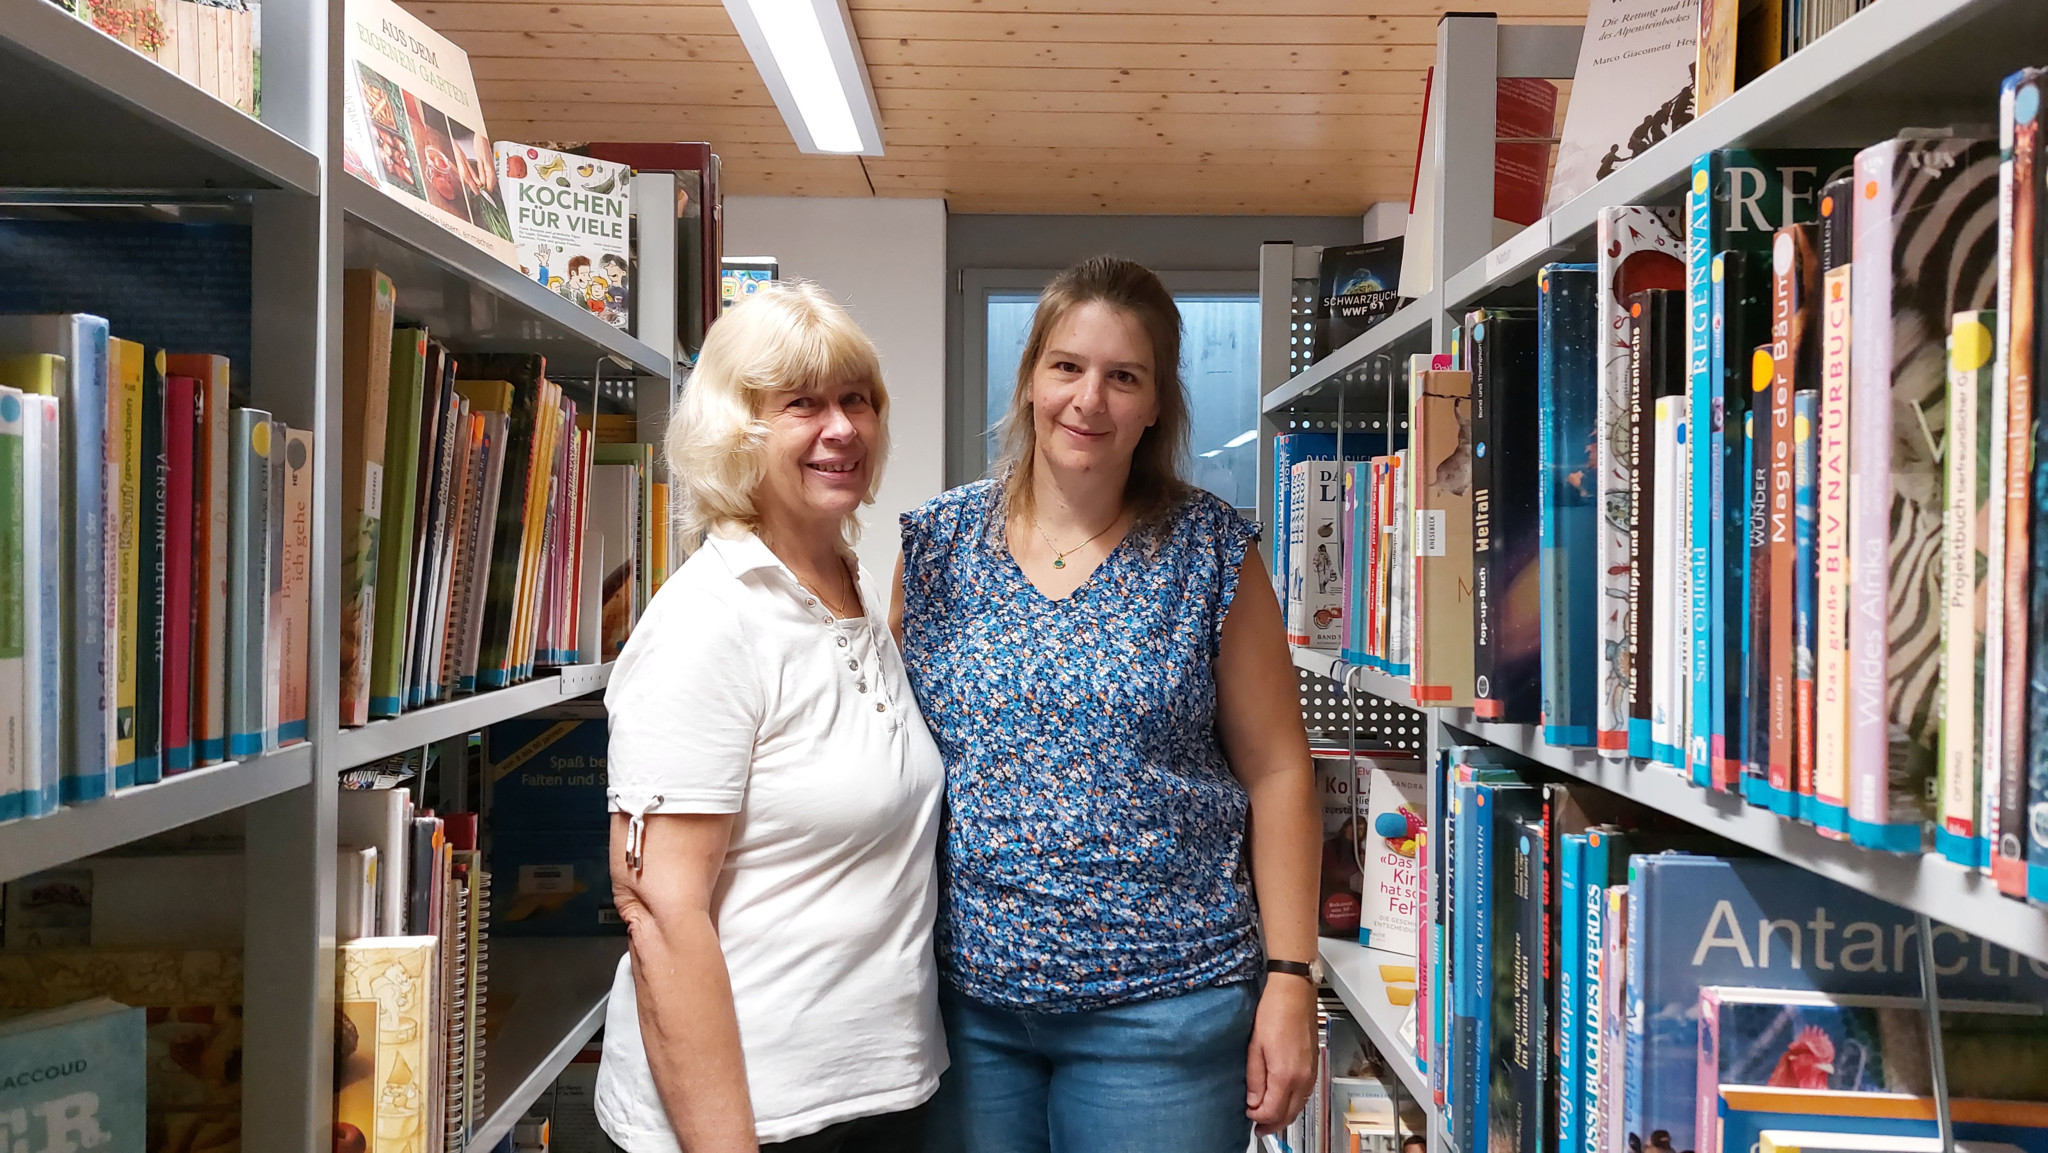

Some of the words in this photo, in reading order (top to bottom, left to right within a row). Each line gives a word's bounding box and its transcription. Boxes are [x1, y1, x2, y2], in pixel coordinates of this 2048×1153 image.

[1599, 28, 1613, 41] des
[1614, 13, 1691, 38] Alpensteinbockes
[1602, 16, 1619, 28] Die
[1621, 10, 1659, 24] Rettung
[1661, 2, 1679, 14] und
[356, 22, 417, 75] EIGENEN
[419, 64, 470, 108] GARTEN
[382, 18, 408, 48] AUS
[408, 36, 440, 69] DEM
[1593, 54, 1620, 67] Marco
[1623, 43, 1671, 59] Giacometti
[519, 183, 623, 218] KOCHEN
[519, 205, 560, 228] FÜR
[567, 214, 623, 240] VIELE
[1724, 164, 1854, 233] RE
[1693, 155, 1708, 375] REGENWAL
[1323, 289, 1398, 307] SCHWARZBUCH
[1342, 306, 1368, 317] WWF
[1773, 275, 1788, 361] Bäum
[1631, 326, 1641, 422] Spitzenkochs
[1773, 375, 1788, 428] der
[124, 397, 133, 482] gewachsen
[1631, 427, 1641, 465] eines
[1956, 388, 1968, 497] tierfreundlicher
[442, 468, 450, 506] KOCHEN
[1630, 469, 1641, 526] Rezepte
[1755, 468, 1767, 547] WUNDER
[1772, 440, 1790, 543] Magie
[85, 512, 97, 535] der
[119, 482, 134, 550] Kraut
[293, 501, 308, 548] gehe
[1475, 488, 1489, 553] Weltall
[85, 539, 97, 572] Buch
[121, 551, 130, 575] ein
[1630, 531, 1640, 556] und
[1826, 514, 1841, 574] BLV
[1952, 498, 1969, 608] Projektbuch
[85, 574, 97, 616] große
[107, 513, 117, 629] Babymassage
[121, 577, 129, 595] ist
[156, 558, 165, 606] DEIN
[282, 540, 293, 599] Bevor
[293, 558, 304, 582] ich
[1694, 547, 1708, 633] Oldfield
[1859, 537, 1883, 621] Afrika
[119, 597, 128, 632] alles
[1479, 567, 1487, 646] Pop-up-Buch
[1630, 562, 1640, 654] Sammeltipps
[1829, 584, 1839, 650] große
[85, 621, 97, 644] Das
[118, 634, 128, 684] Gegen
[1694, 637, 1708, 683] Sara
[1826, 662, 1837, 703] Das
[1859, 630, 1883, 727] Wildes
[1629, 668, 1639, 703] Pilze
[1776, 675, 1784, 740] LAUDERT
[521, 773, 563, 786] Falten
[568, 773, 595, 786] und
[550, 755, 585, 774] Spaß
[1391, 780, 1424, 790] SANDRA
[1542, 803, 1550, 865] PUMAS
[1380, 882, 1402, 896] hat
[1542, 869, 1550, 906] UND
[1628, 893, 1638, 932] Mike
[1542, 912, 1550, 980] LUCHSE
[1586, 884, 1601, 982] PFERDES
[1476, 943, 1484, 999] ZAUBER
[1514, 932, 1522, 998] Wildtiere
[1521, 955, 1529, 990] Bern
[1627, 936, 1637, 987] Lucas
[1520, 993, 1529, 1047] Kanton
[1560, 971, 1575, 1069] Europas
[1586, 983, 1601, 1034] DES
[1585, 1034, 1600, 1096] BUCH
[1624, 1005, 1638, 1123] Antarctica
